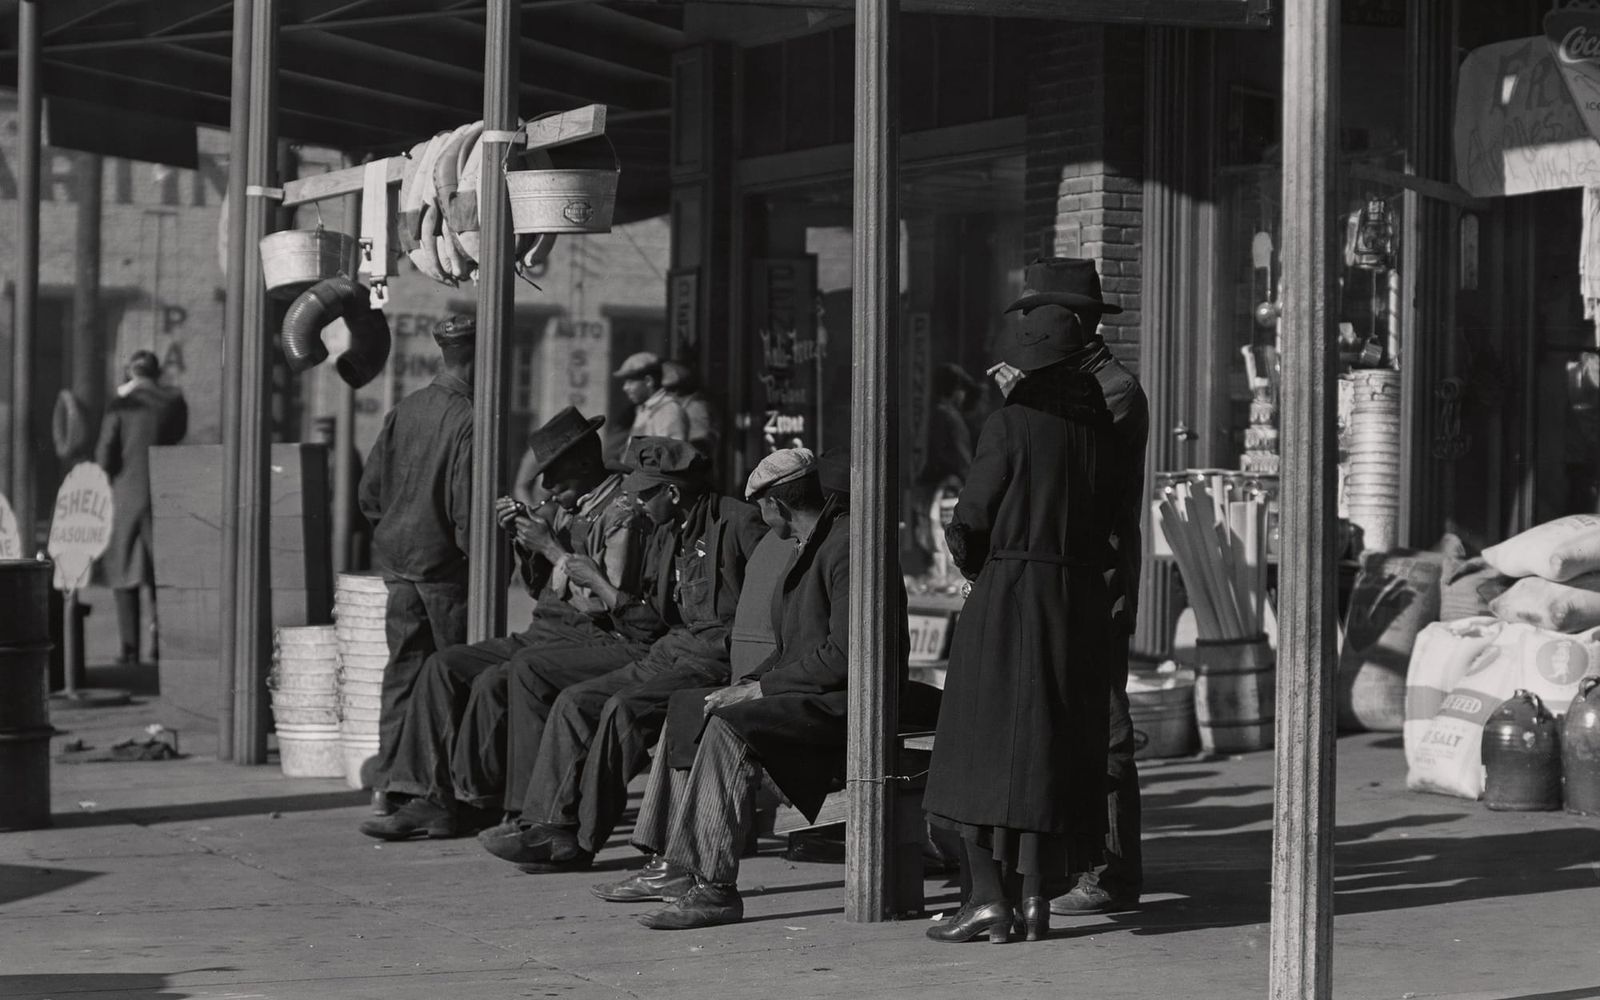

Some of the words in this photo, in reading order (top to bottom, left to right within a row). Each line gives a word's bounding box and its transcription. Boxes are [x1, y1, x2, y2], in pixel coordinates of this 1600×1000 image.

[57, 489, 107, 521] SHELL
[51, 525, 106, 544] GASOLINE
[1431, 730, 1464, 748] SALT
